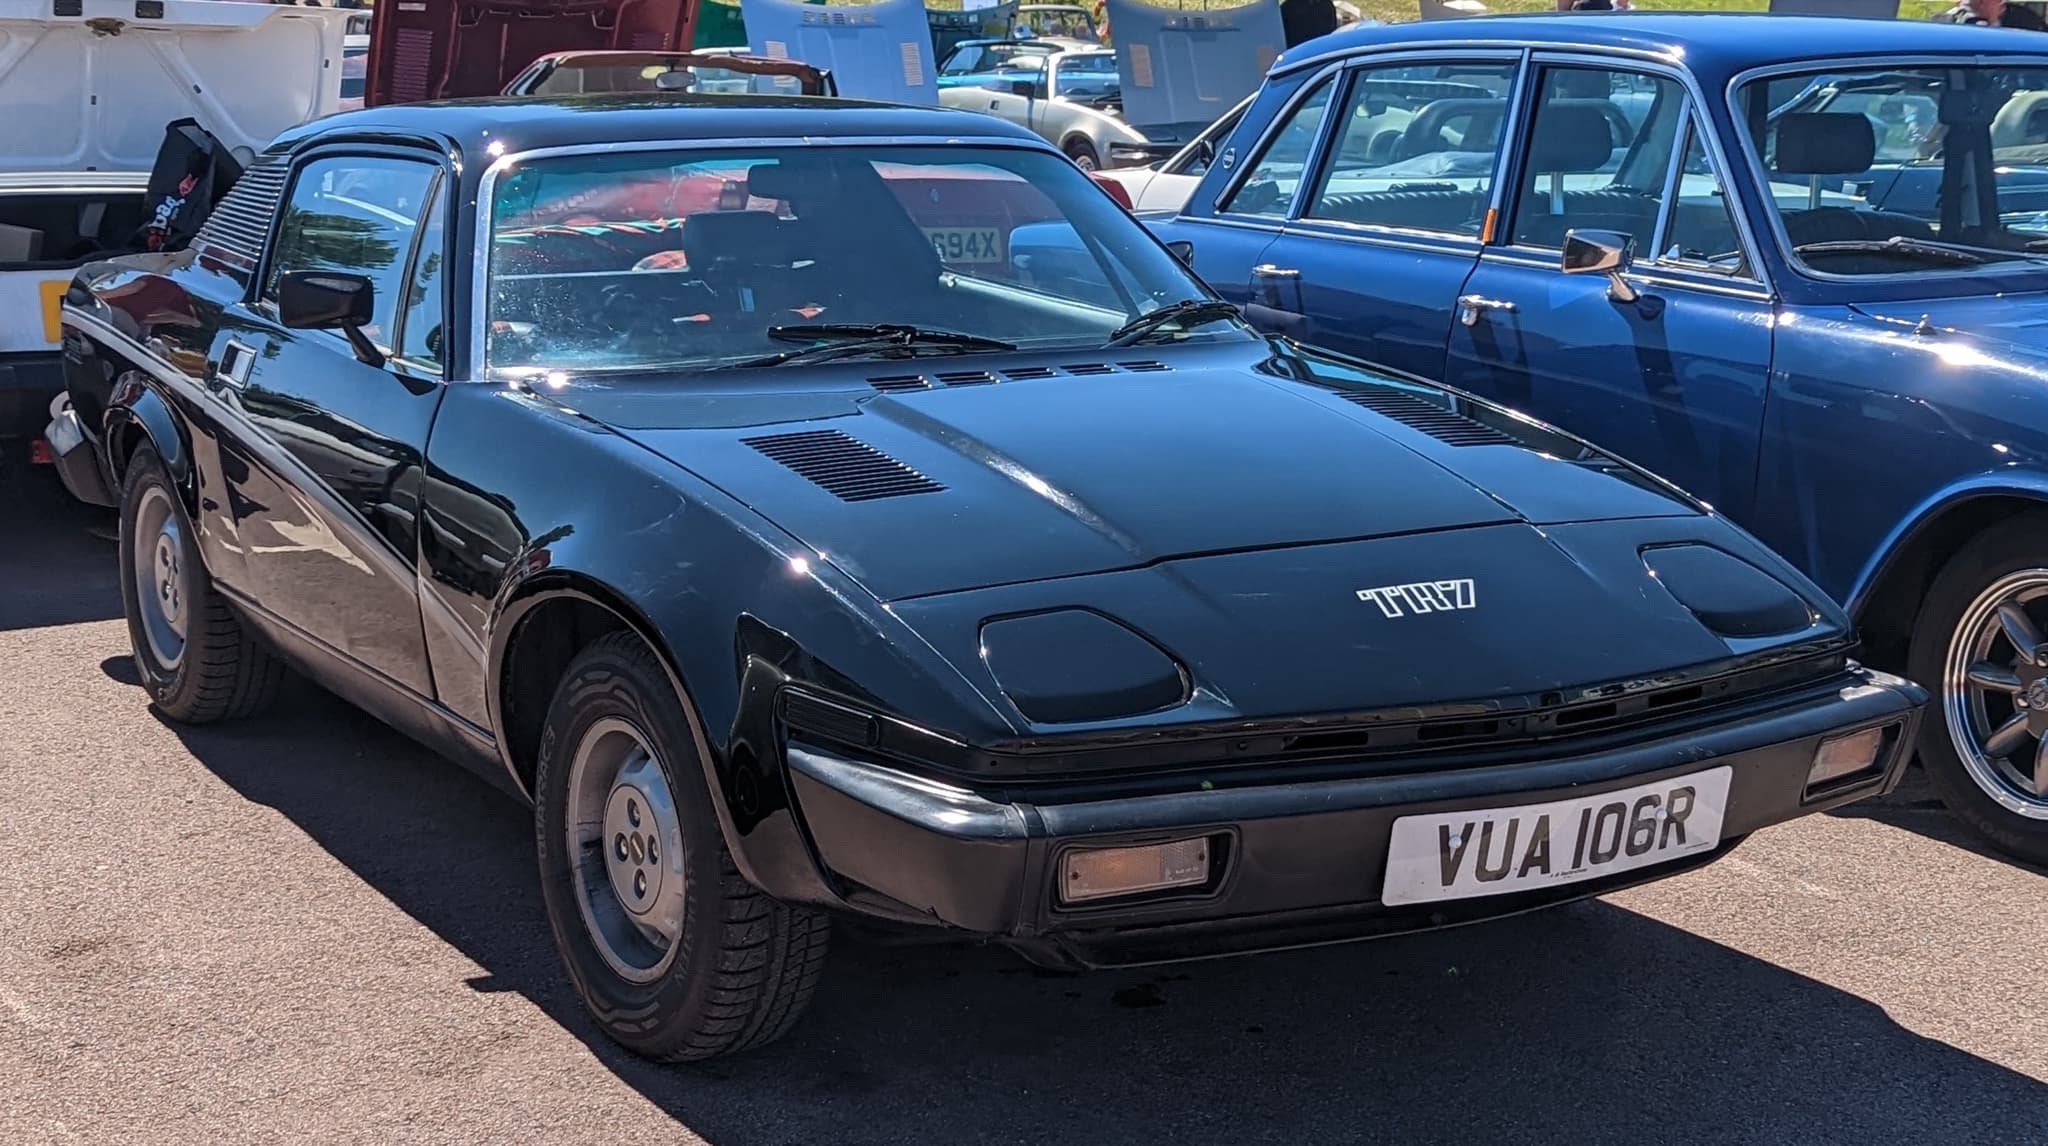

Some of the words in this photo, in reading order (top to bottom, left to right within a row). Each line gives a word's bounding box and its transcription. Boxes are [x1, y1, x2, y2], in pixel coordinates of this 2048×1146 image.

[1356, 578, 1476, 618] TR7
[1438, 814, 1551, 887] VUA
[1571, 786, 1696, 870] 106R
